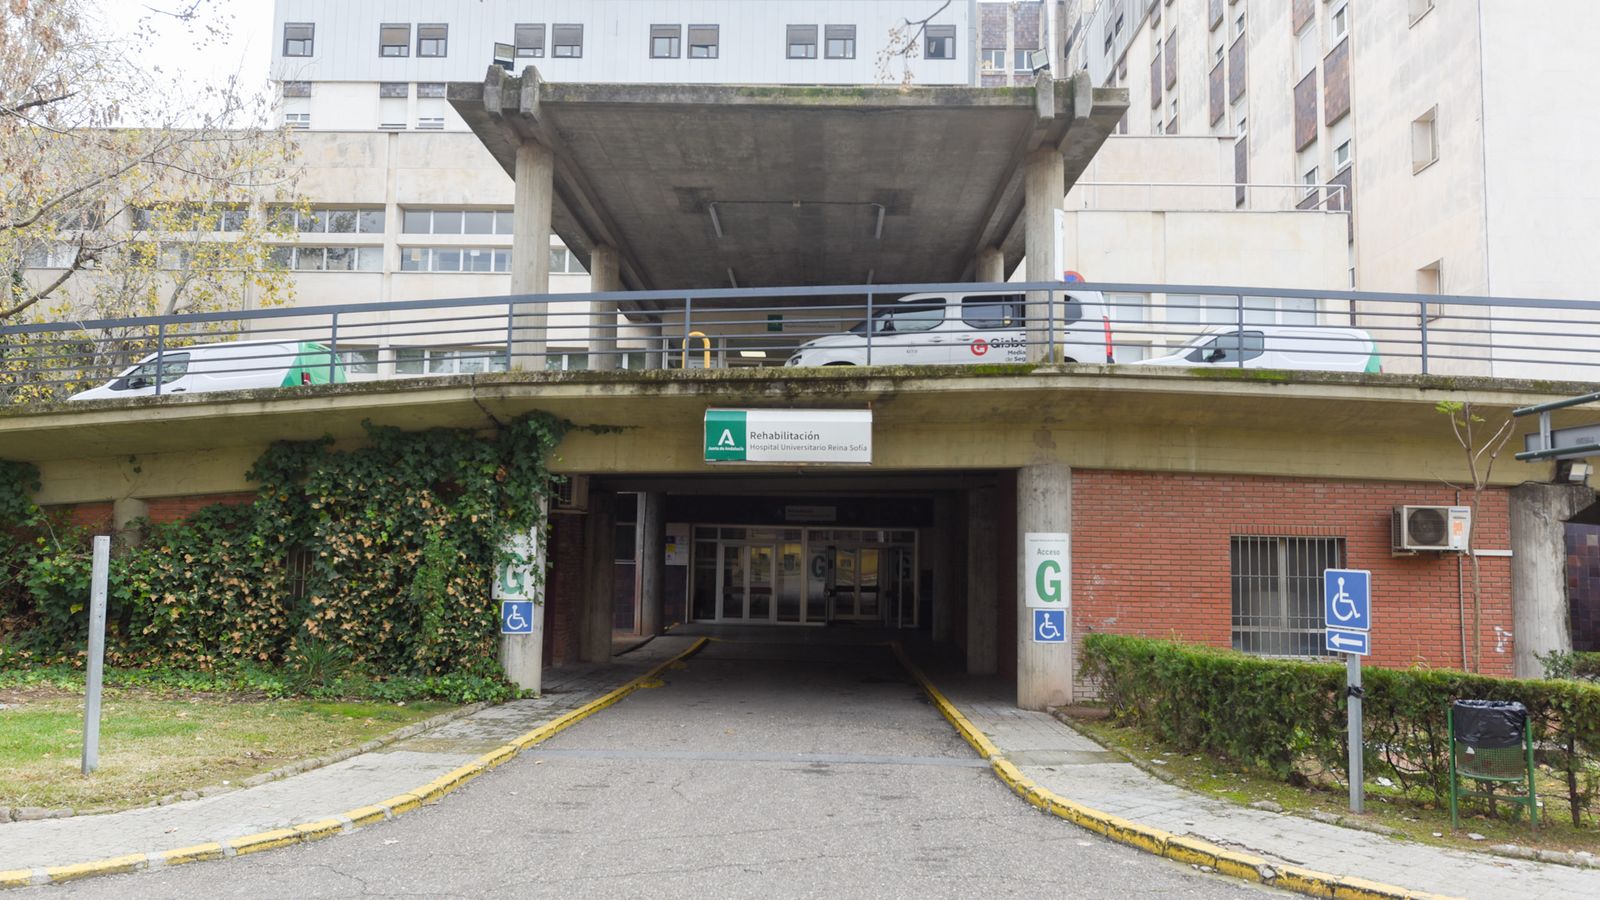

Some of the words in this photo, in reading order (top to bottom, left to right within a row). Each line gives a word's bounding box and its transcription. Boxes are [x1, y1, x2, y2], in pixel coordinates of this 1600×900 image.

[750, 431, 820, 441] Rehabilitación
[750, 443, 779, 452] Hospital
[828, 444, 848, 452] Reina
[849, 444, 868, 452] Sofía
[1037, 548, 1061, 556] Acceso
[499, 552, 525, 594] G
[812, 555, 826, 578] G
[1036, 560, 1061, 602] G
